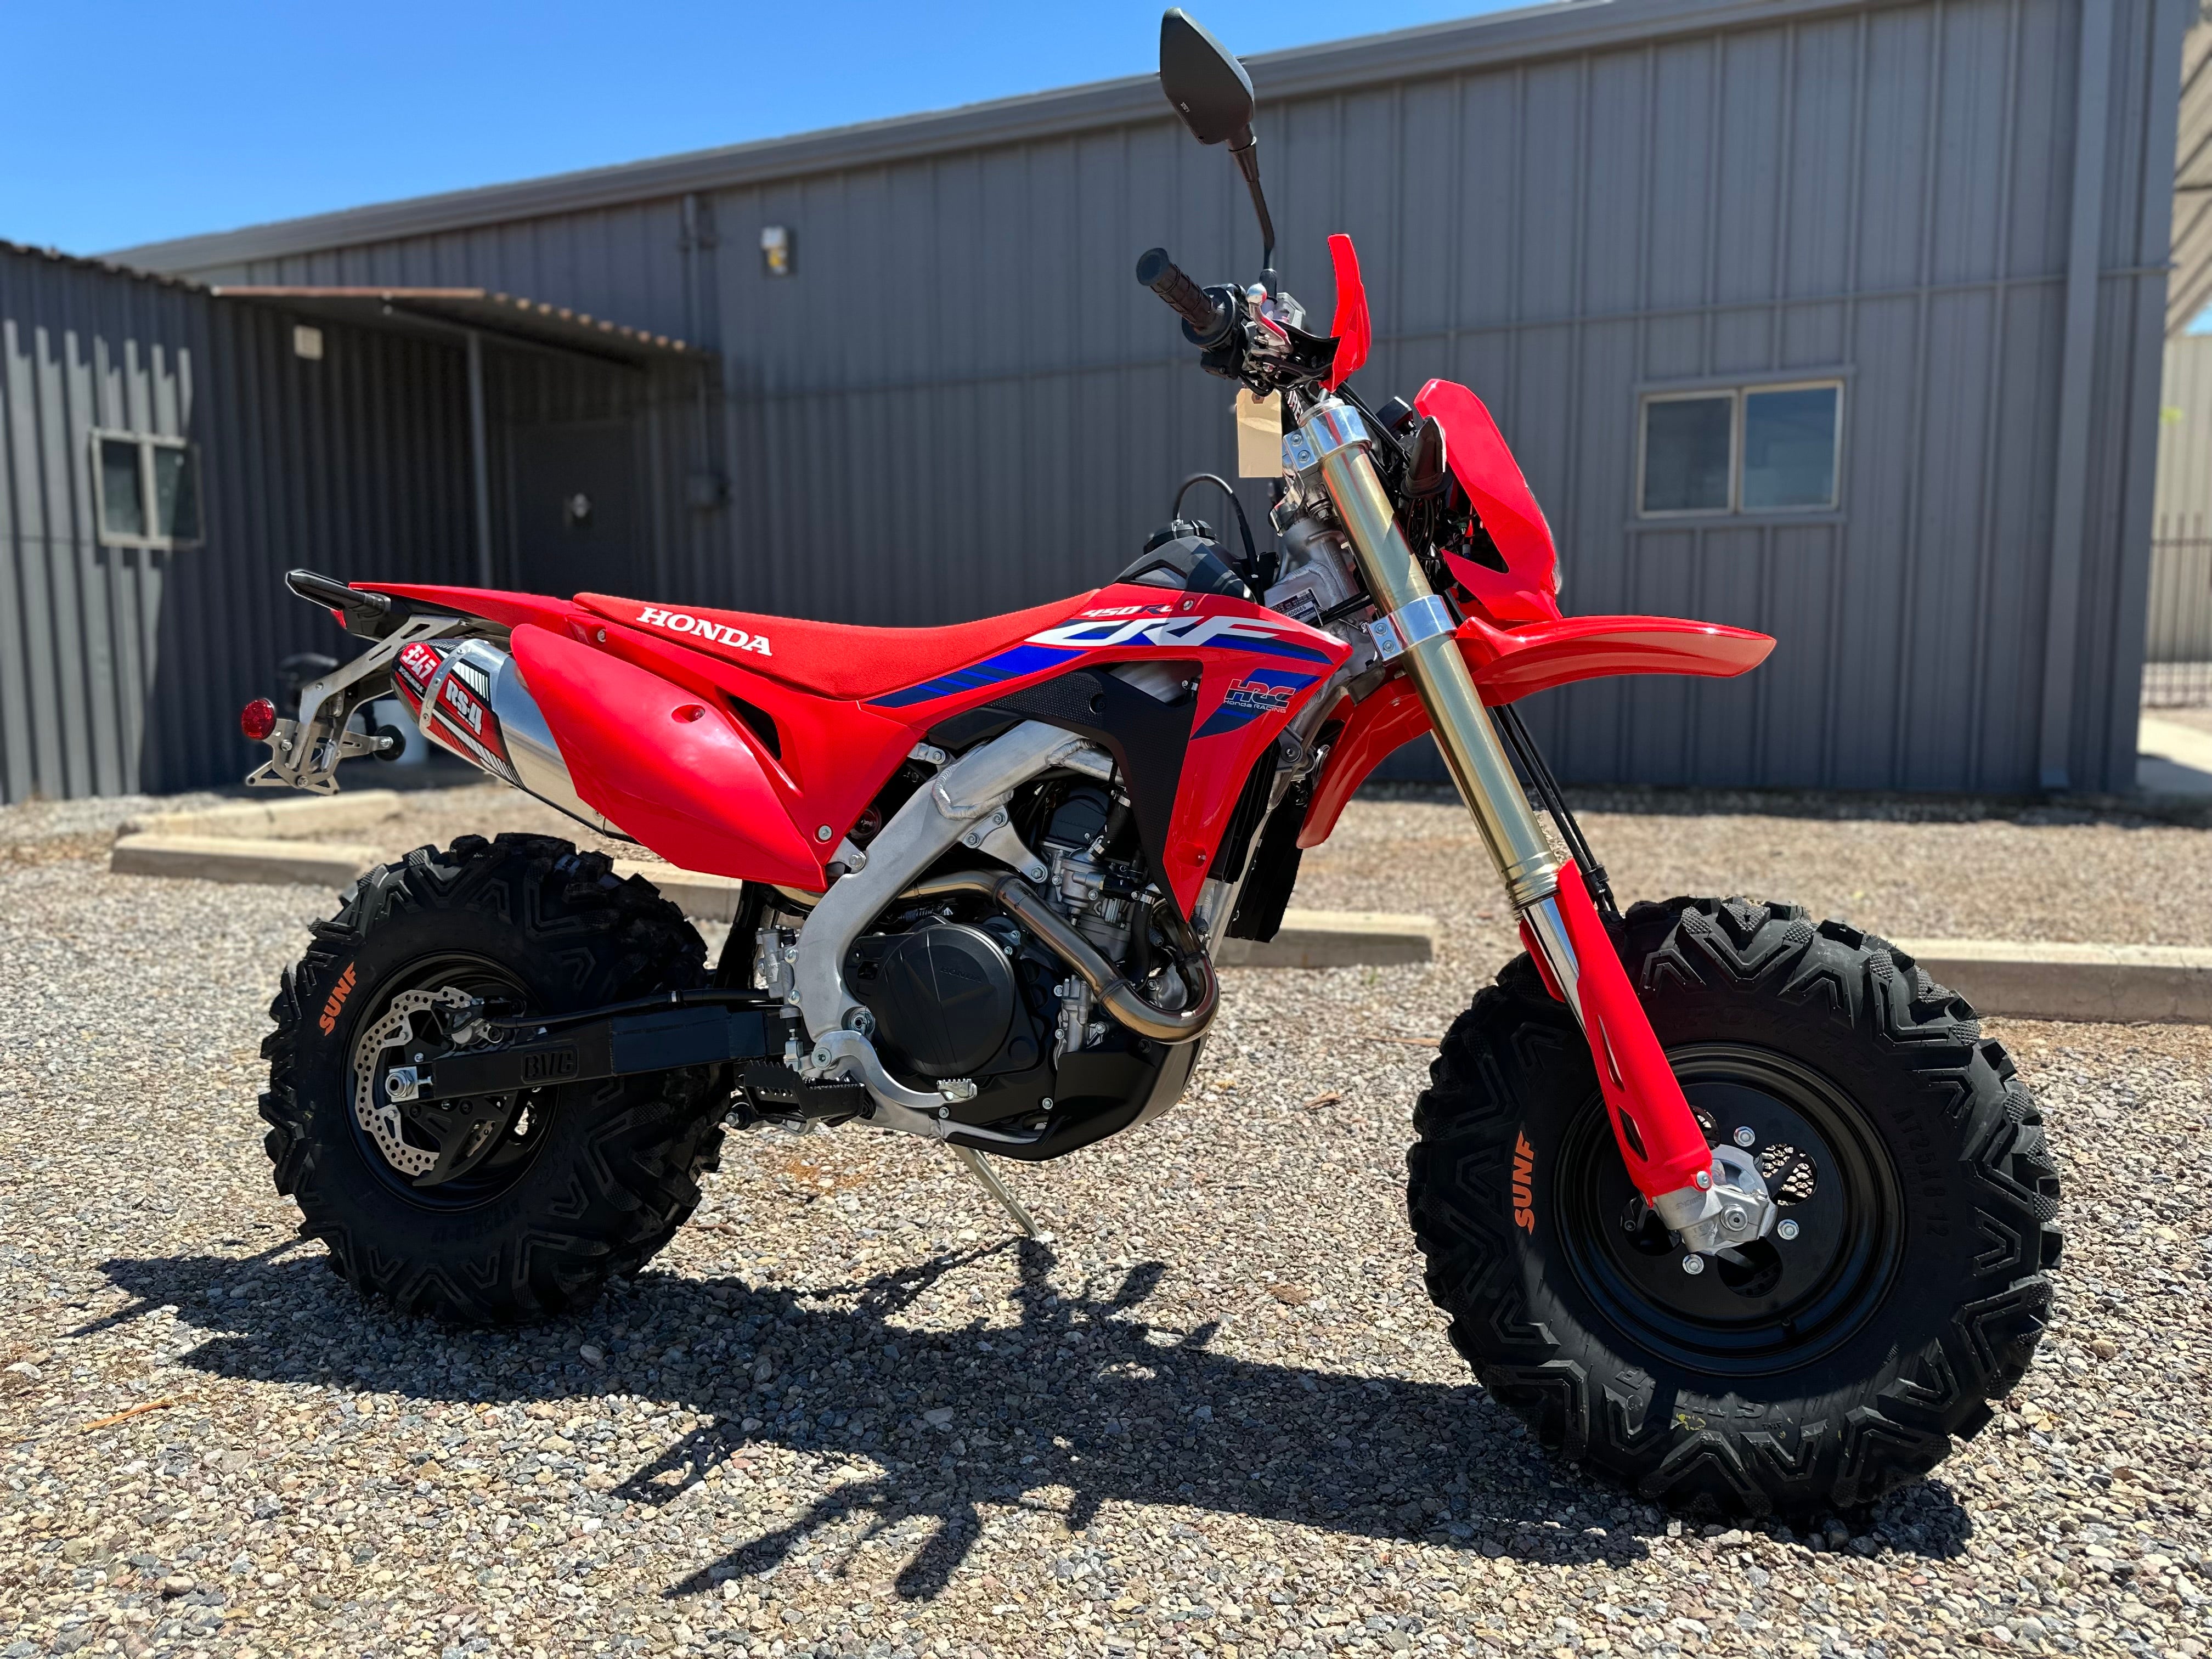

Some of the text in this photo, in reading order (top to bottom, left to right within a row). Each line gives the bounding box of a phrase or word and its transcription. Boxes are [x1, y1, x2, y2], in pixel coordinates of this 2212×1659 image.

[1023, 616, 1302, 646] CRF
[1080, 603, 1172, 618] 450RL
[635, 606, 772, 657] HONDA
[445, 679, 483, 736] RS-4
[1223, 699, 1286, 714] Honda RACING
[1224, 678, 1296, 709] HRC
[319, 961, 357, 1036] SUNF
[1512, 1130, 1535, 1235] SUNF
